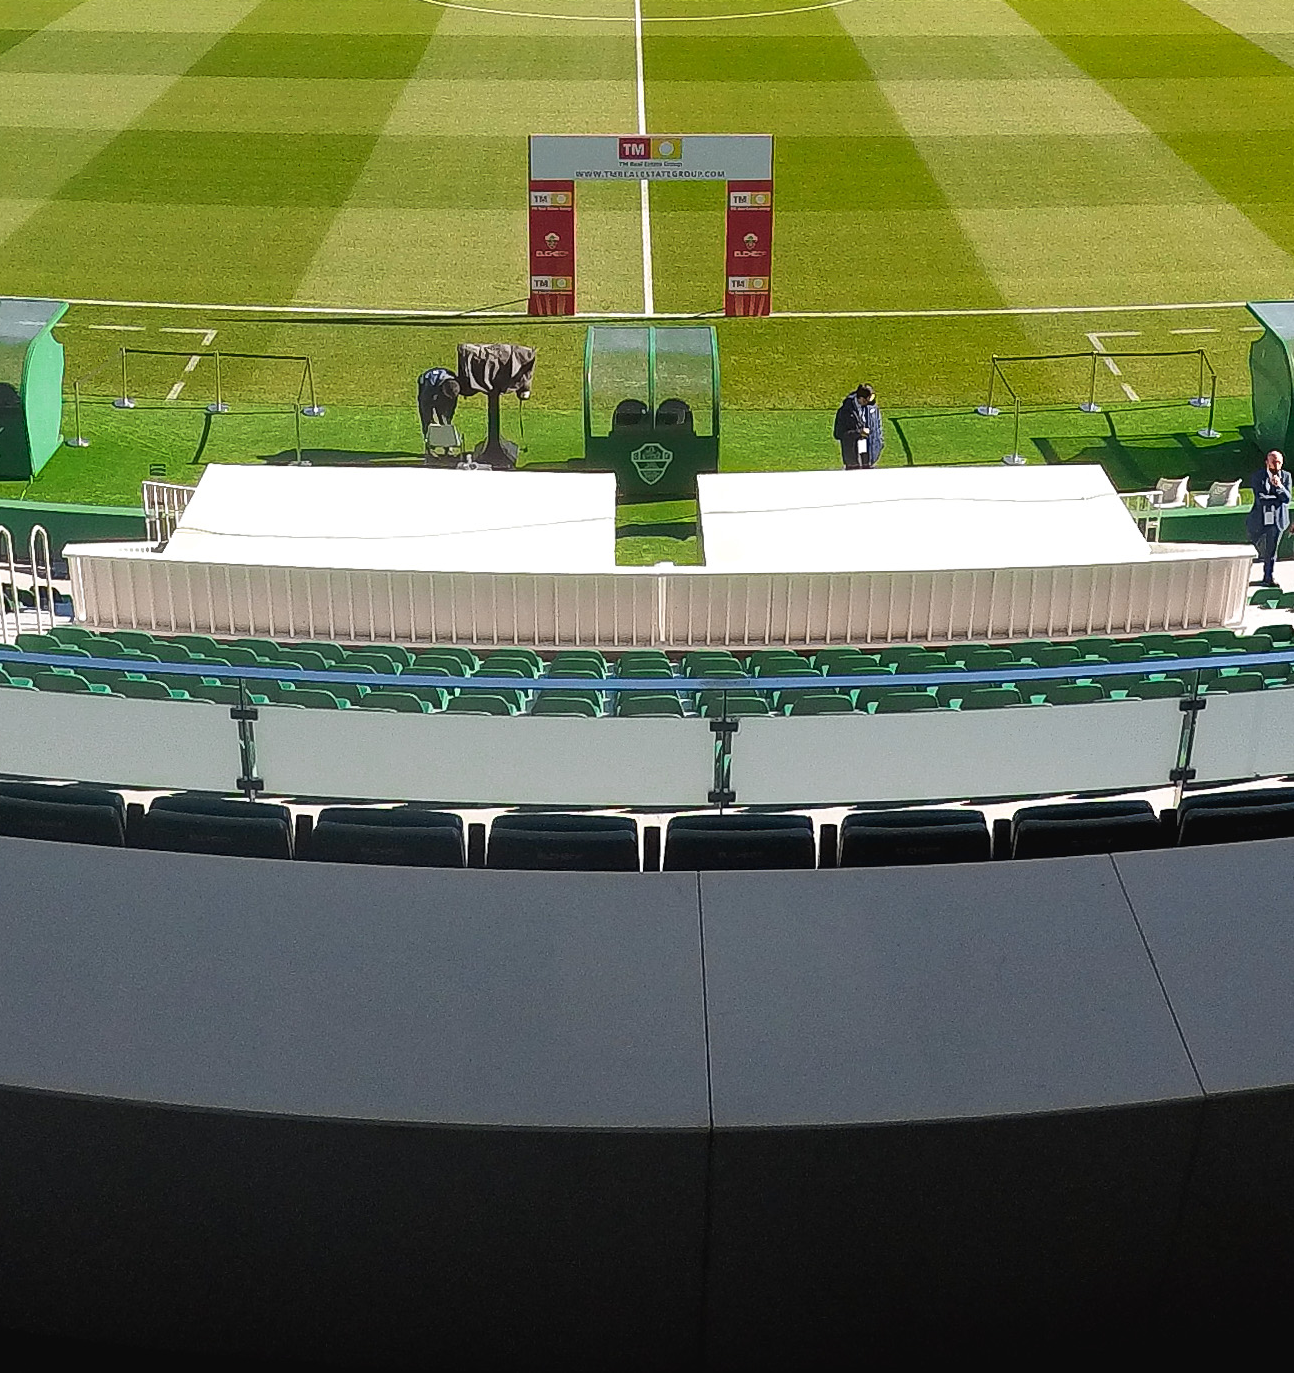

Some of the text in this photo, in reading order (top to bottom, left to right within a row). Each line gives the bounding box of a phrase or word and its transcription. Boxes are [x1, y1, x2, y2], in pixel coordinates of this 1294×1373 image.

[623, 143, 645, 156] TM
[575, 170, 725, 178] WWW.TMREALESTATEGROUP.COM
[534, 195, 548, 203] TM
[733, 195, 747, 204] TM
[534, 279, 549, 288] TM
[731, 279, 745, 288] TM
